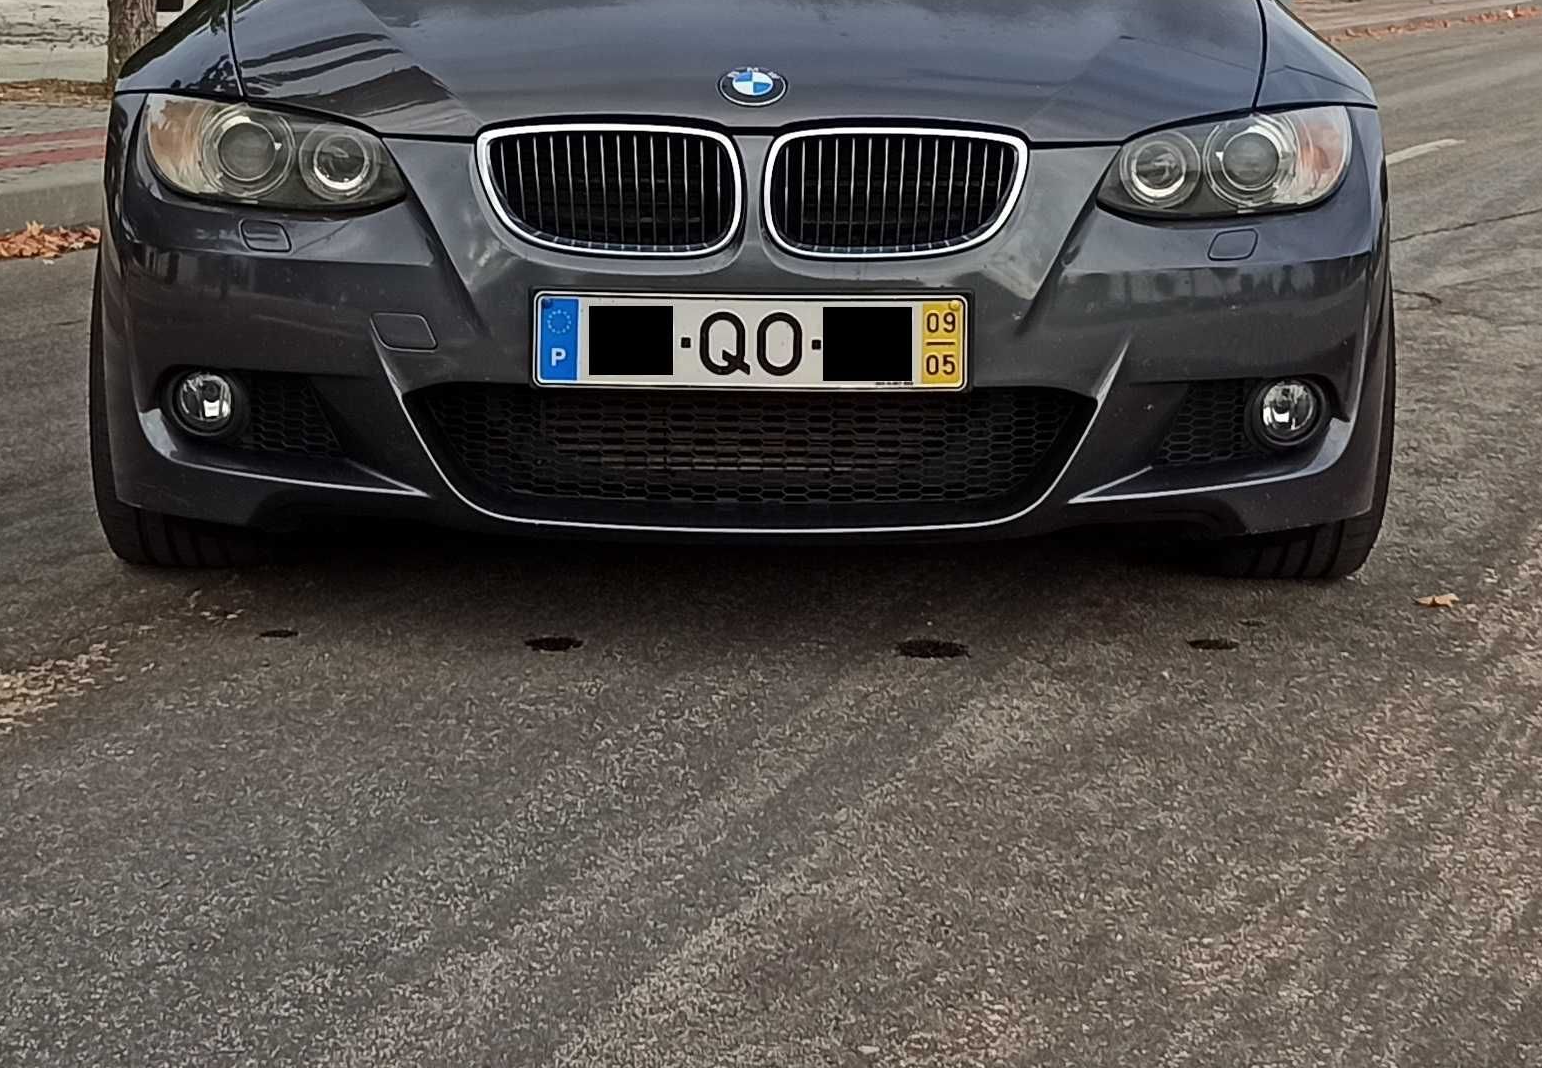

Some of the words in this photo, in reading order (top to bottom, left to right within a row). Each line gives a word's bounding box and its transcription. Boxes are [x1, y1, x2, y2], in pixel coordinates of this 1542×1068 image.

[926, 312, 956, 334] 09
[551, 347, 567, 366] P
[926, 354, 956, 376] 05
